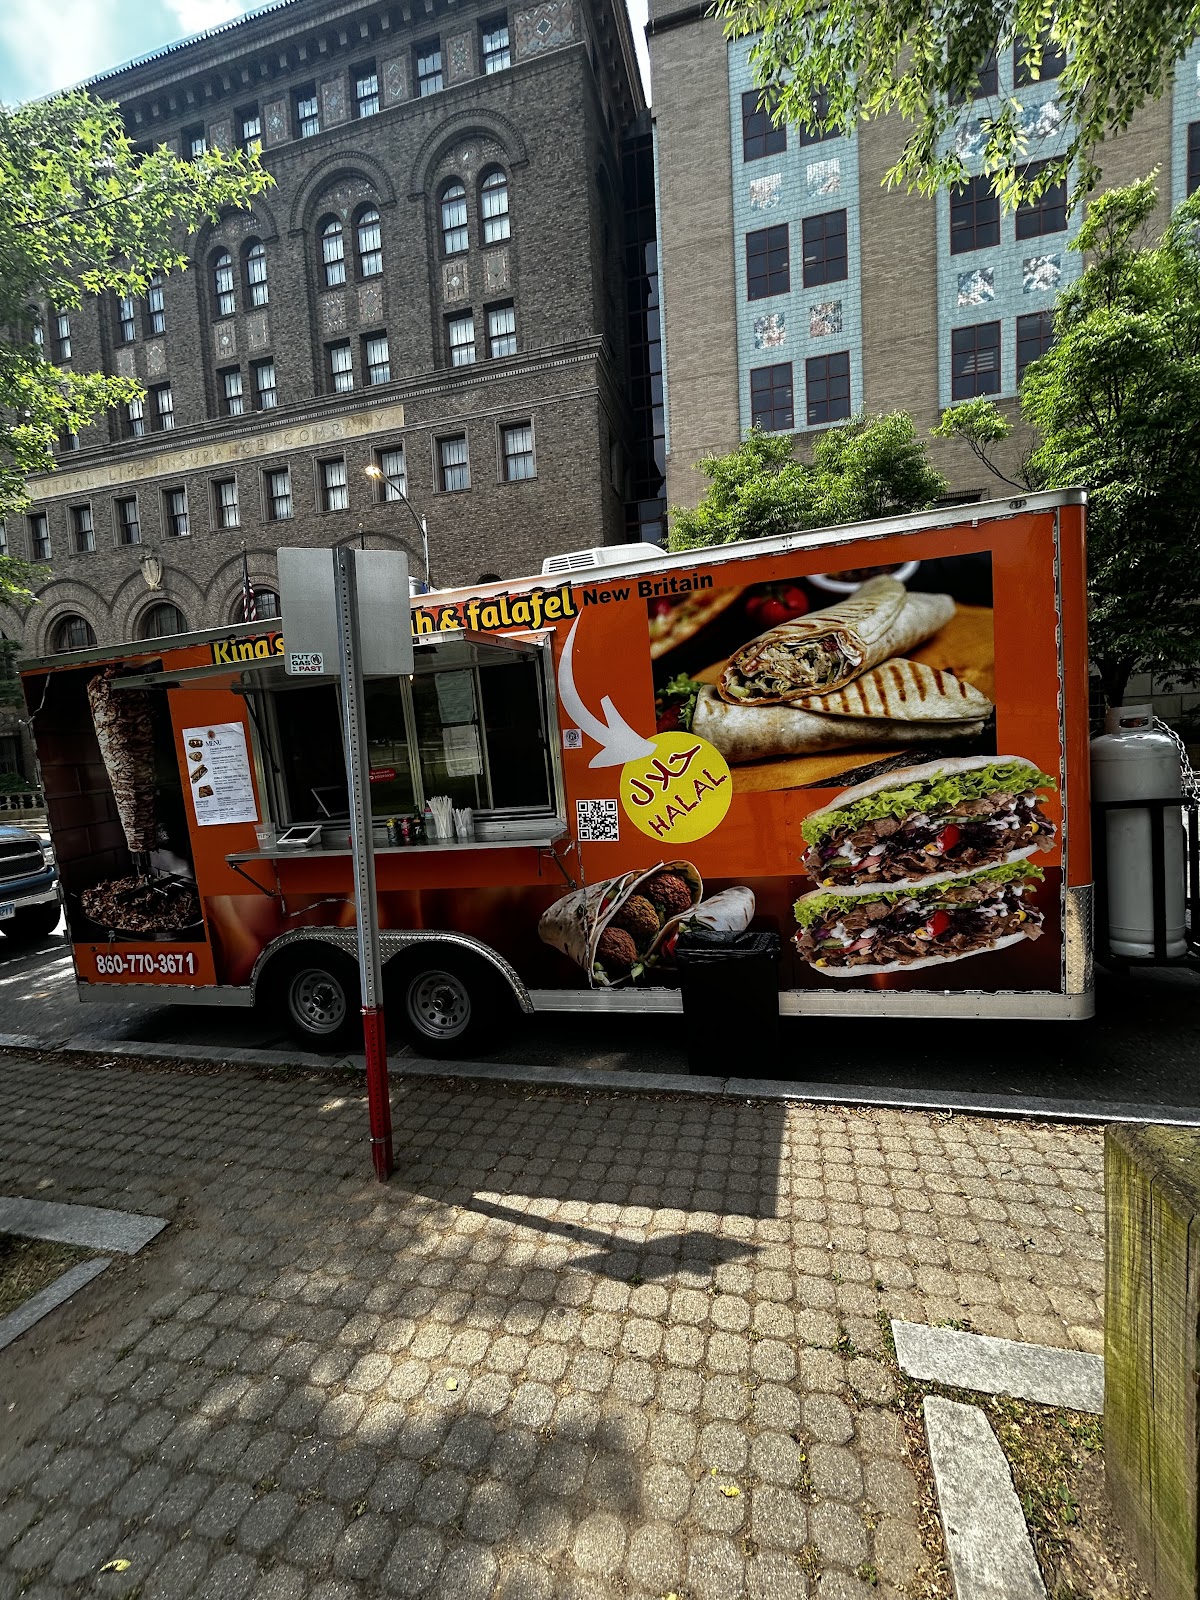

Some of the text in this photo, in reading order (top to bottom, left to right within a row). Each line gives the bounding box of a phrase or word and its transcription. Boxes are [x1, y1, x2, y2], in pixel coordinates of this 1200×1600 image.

[109, 462, 145, 481] LIFE
[159, 438, 266, 470] INSURANCE
[284, 413, 386, 445] COMPANY
[440, 609, 458, 630] &
[467, 586, 575, 632] falafel
[583, 573, 713, 606] New Britain
[205, 739, 222, 747] MENU
[630, 743, 702, 806] حلال
[648, 768, 728, 837] HALAL
[96, 952, 195, 975] 860-770-3671
